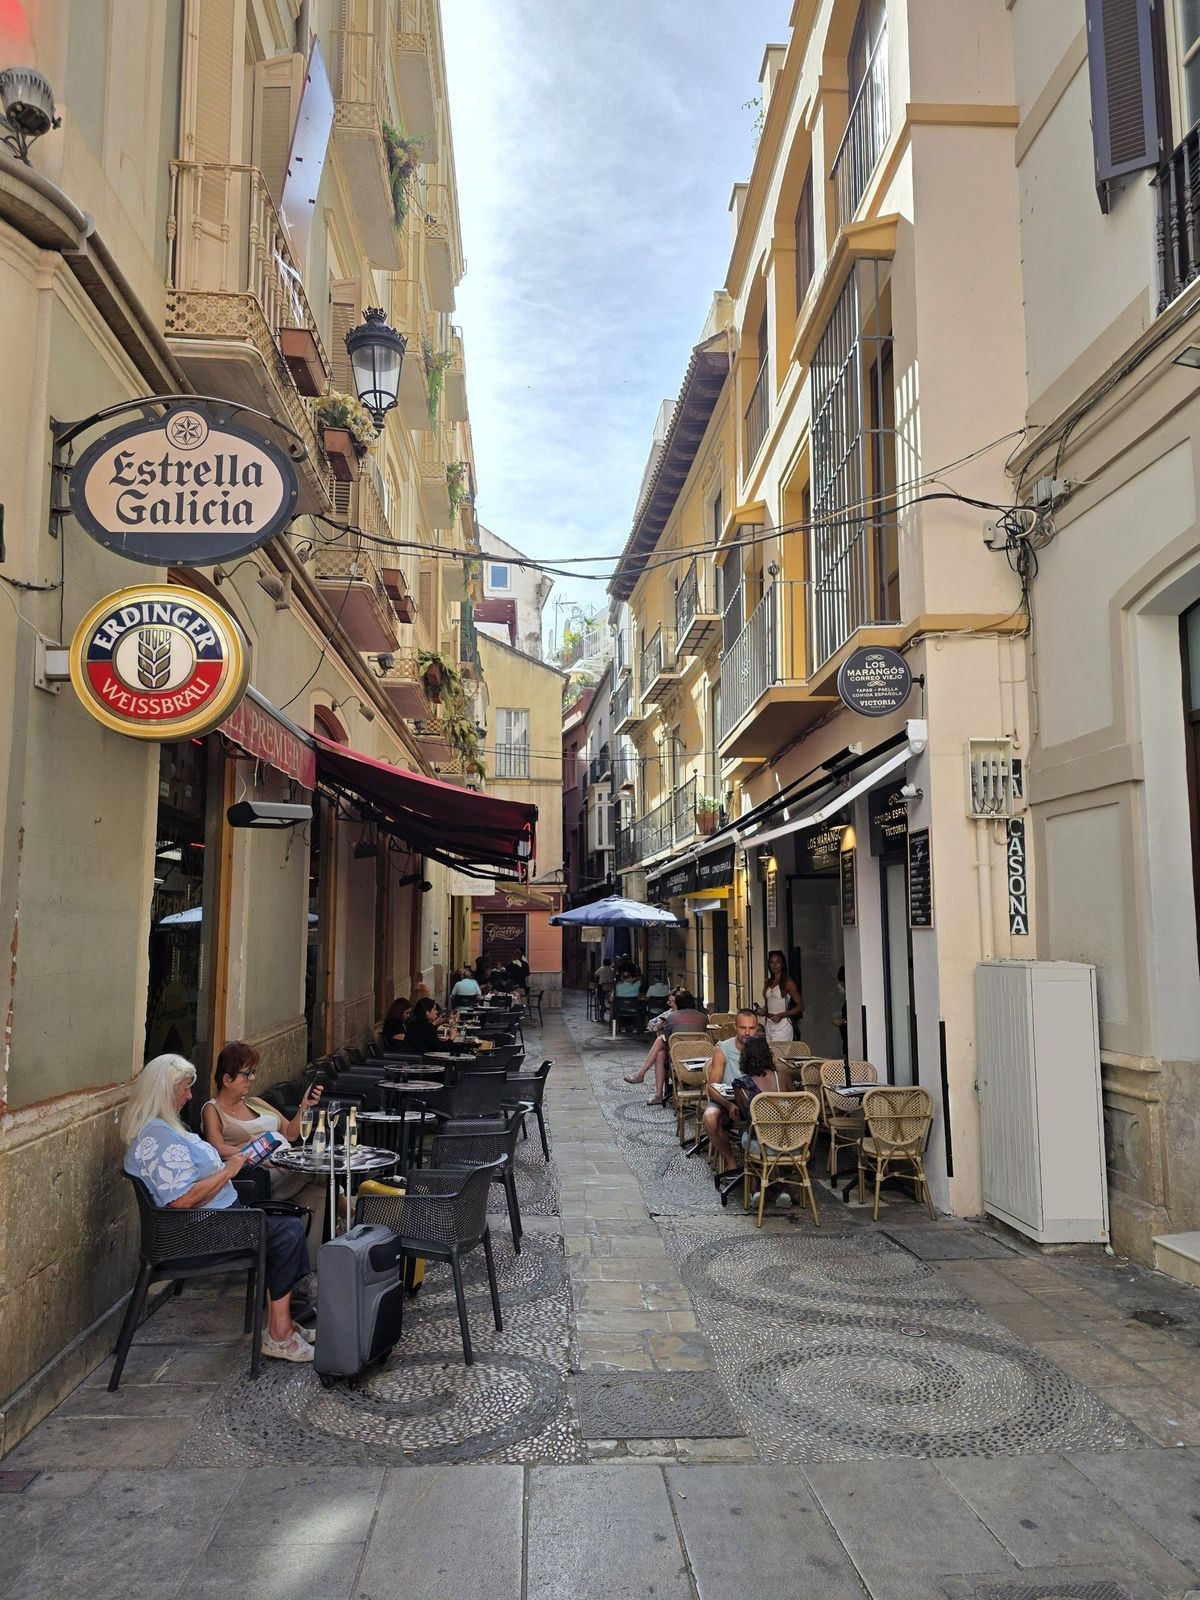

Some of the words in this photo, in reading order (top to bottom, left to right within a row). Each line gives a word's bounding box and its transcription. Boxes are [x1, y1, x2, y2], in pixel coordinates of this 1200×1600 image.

[109, 450, 264, 488] Estrella
[116, 489, 254, 525] Galicia
[92, 603, 215, 651] ERDINGER
[847, 666, 905, 676] MARANGÓS
[865, 661, 886, 669] LOS
[102, 677, 211, 715] WEISSBRÄU
[250, 711, 300, 775] PREMIER
[1007, 818, 1028, 935] CASONA
